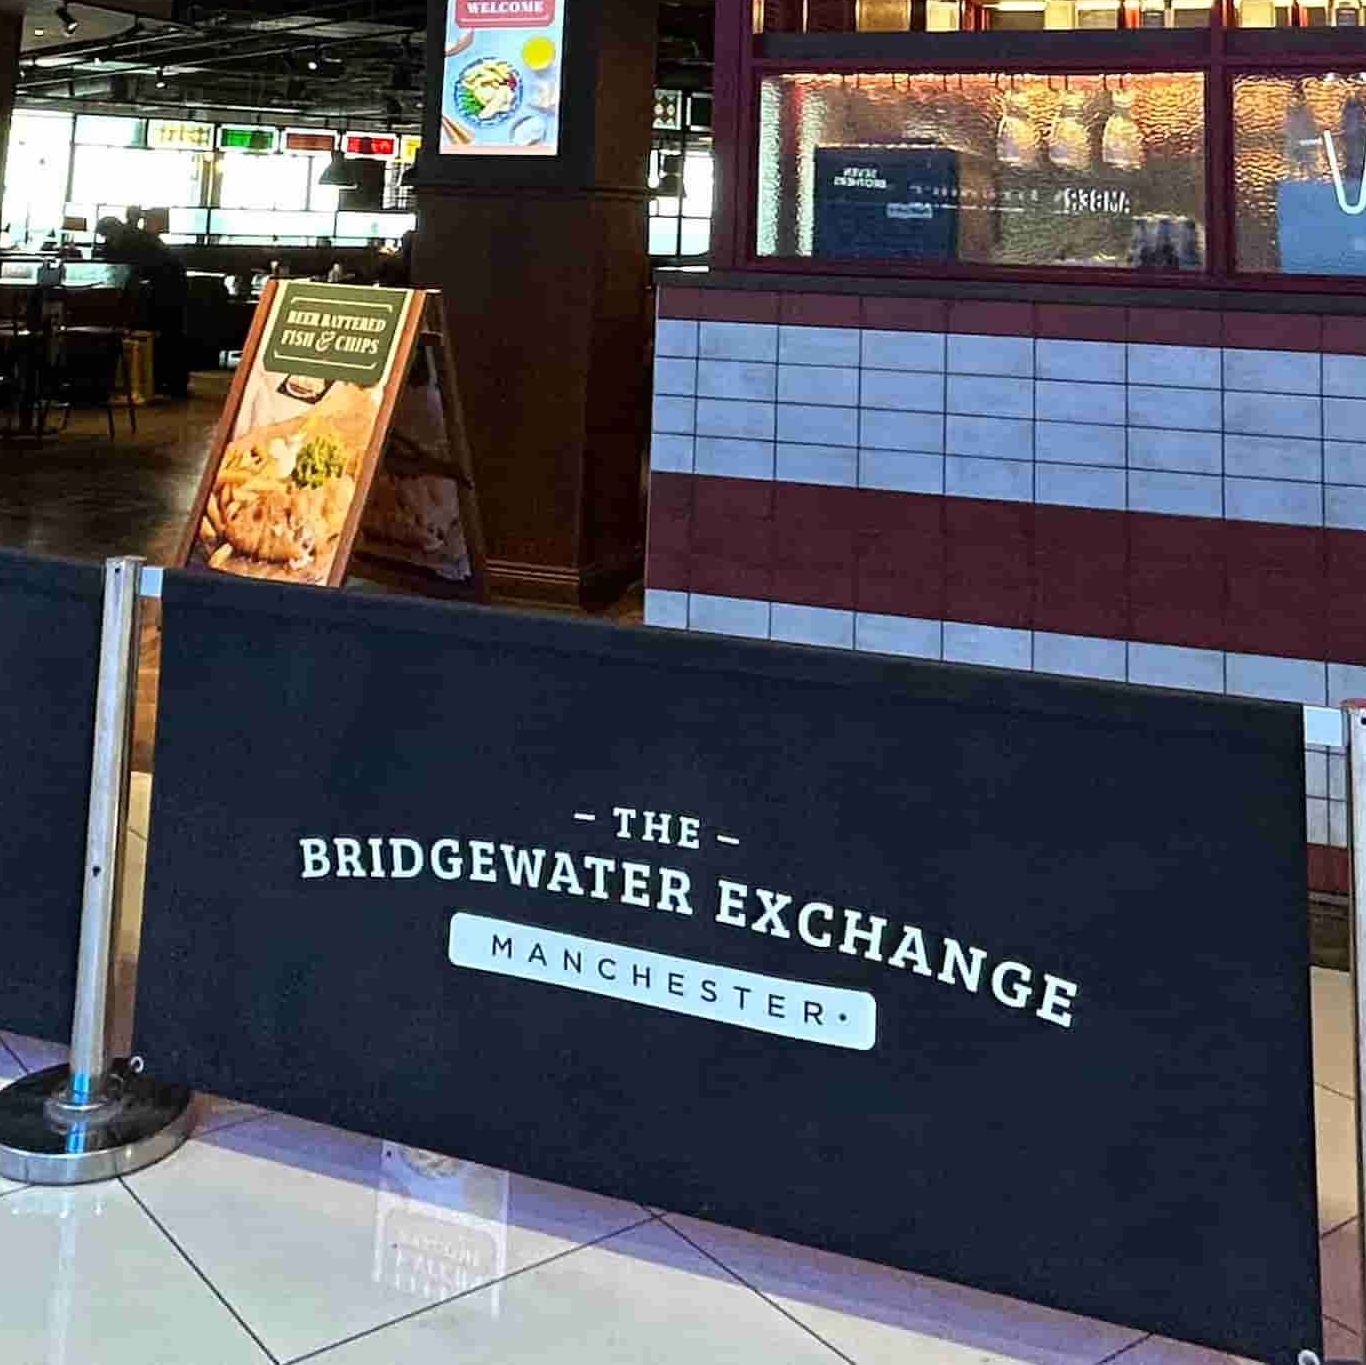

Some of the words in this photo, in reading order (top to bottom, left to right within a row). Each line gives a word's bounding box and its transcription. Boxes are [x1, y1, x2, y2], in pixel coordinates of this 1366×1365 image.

[466, 1, 545, 14] WELCOME
[287, 310, 320, 326] BEER
[280, 329, 316, 347] FISH
[315, 331, 336, 352] &
[335, 335, 380, 355] CHIPS
[611, 805, 702, 850] THE
[299, 836, 694, 916] BRIDGEWATER
[714, 879, 1080, 1029] EXCHANGE
[490, 933, 825, 1027] MANCHESTER
